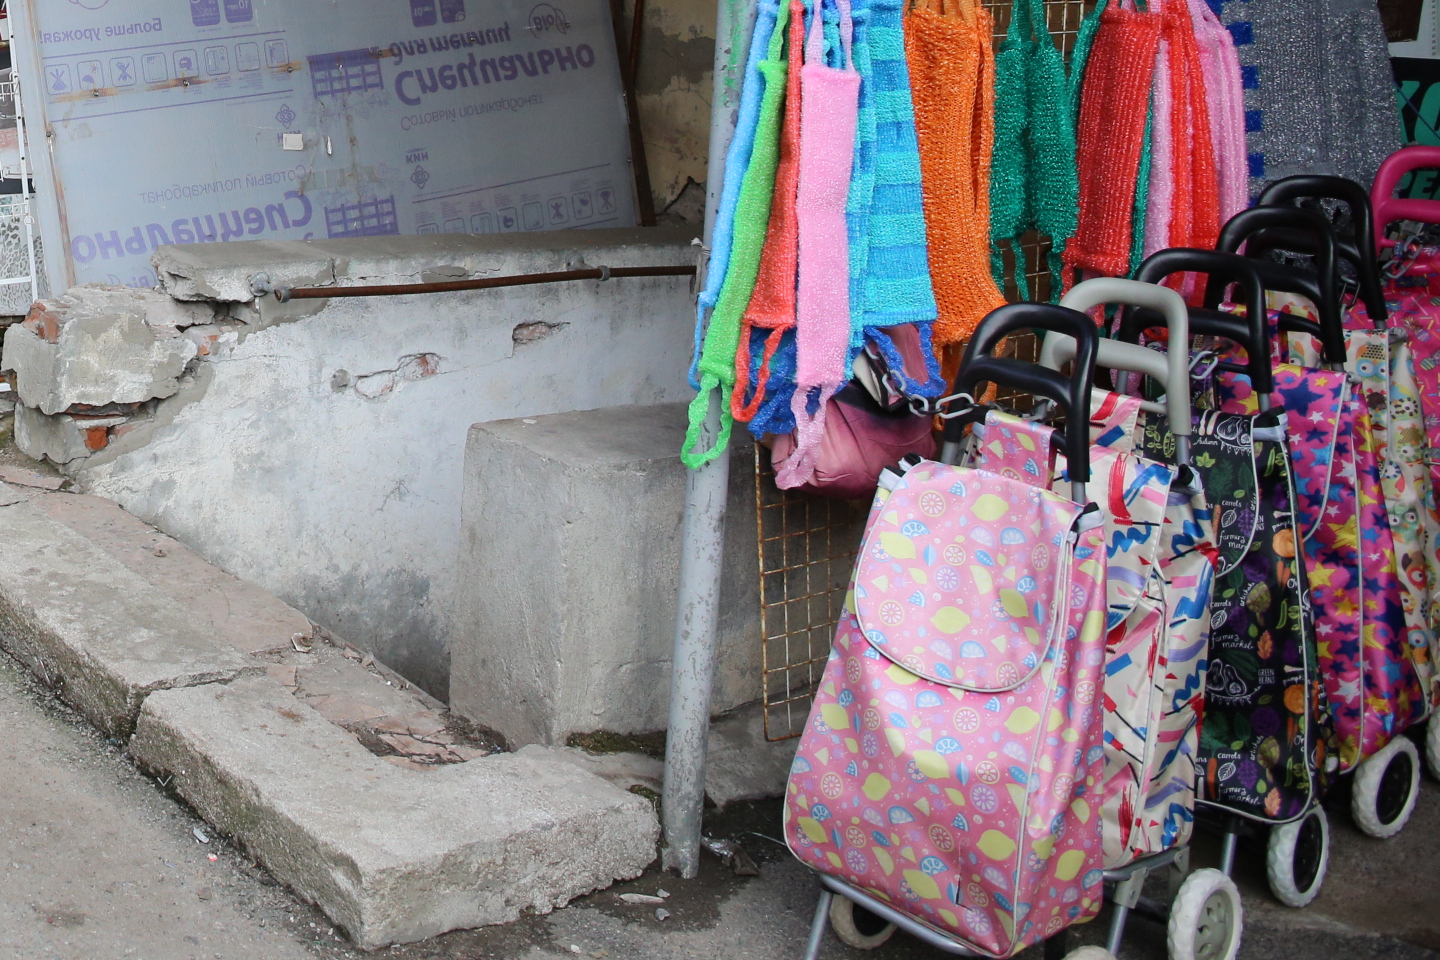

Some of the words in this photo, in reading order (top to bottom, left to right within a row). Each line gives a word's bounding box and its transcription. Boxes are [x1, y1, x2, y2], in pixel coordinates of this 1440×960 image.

[1192, 437, 1218, 445] Autumn
[1221, 500, 1242, 508] carrots
[1258, 676, 1275, 684] BEANS
